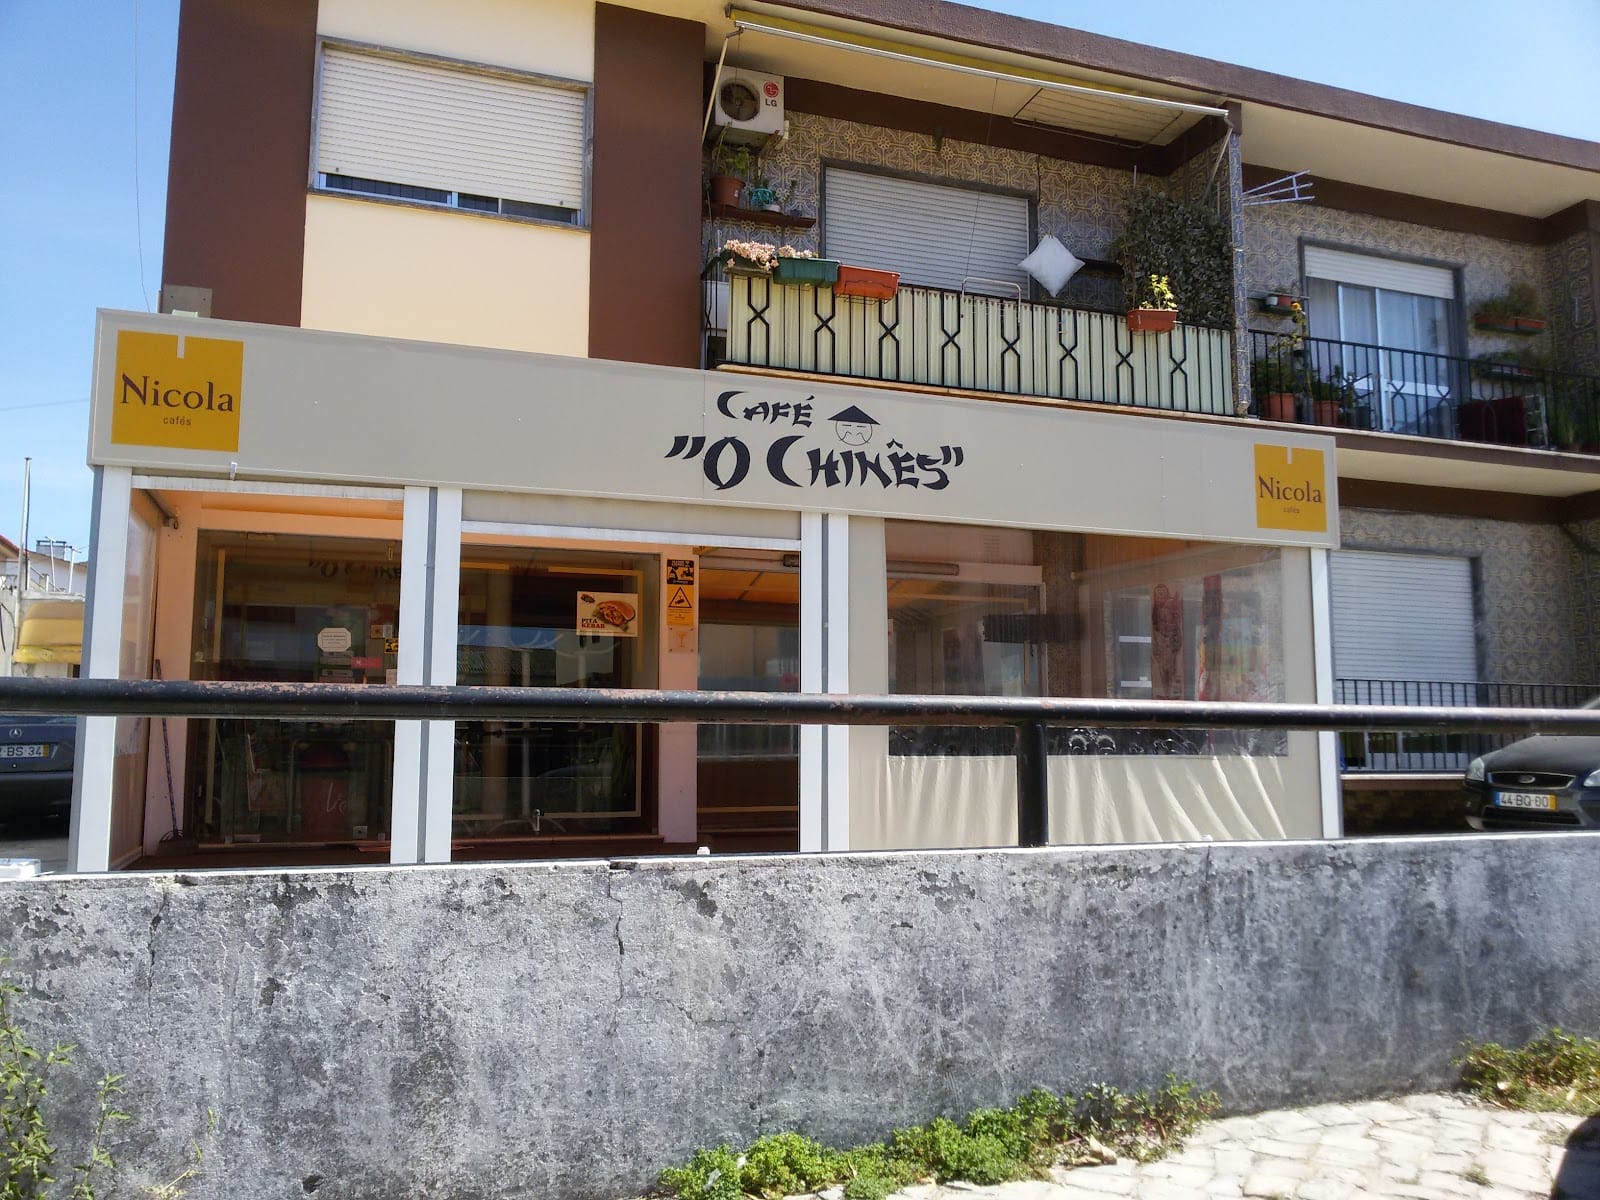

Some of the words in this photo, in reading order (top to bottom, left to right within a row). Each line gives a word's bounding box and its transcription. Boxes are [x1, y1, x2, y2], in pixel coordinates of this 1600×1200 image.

[765, 98, 776, 106] LG
[120, 373, 233, 412] Nicola
[163, 416, 192, 426] cafés
[716, 390, 815, 428] CAFÉ
[1258, 476, 1321, 502] Nicola
